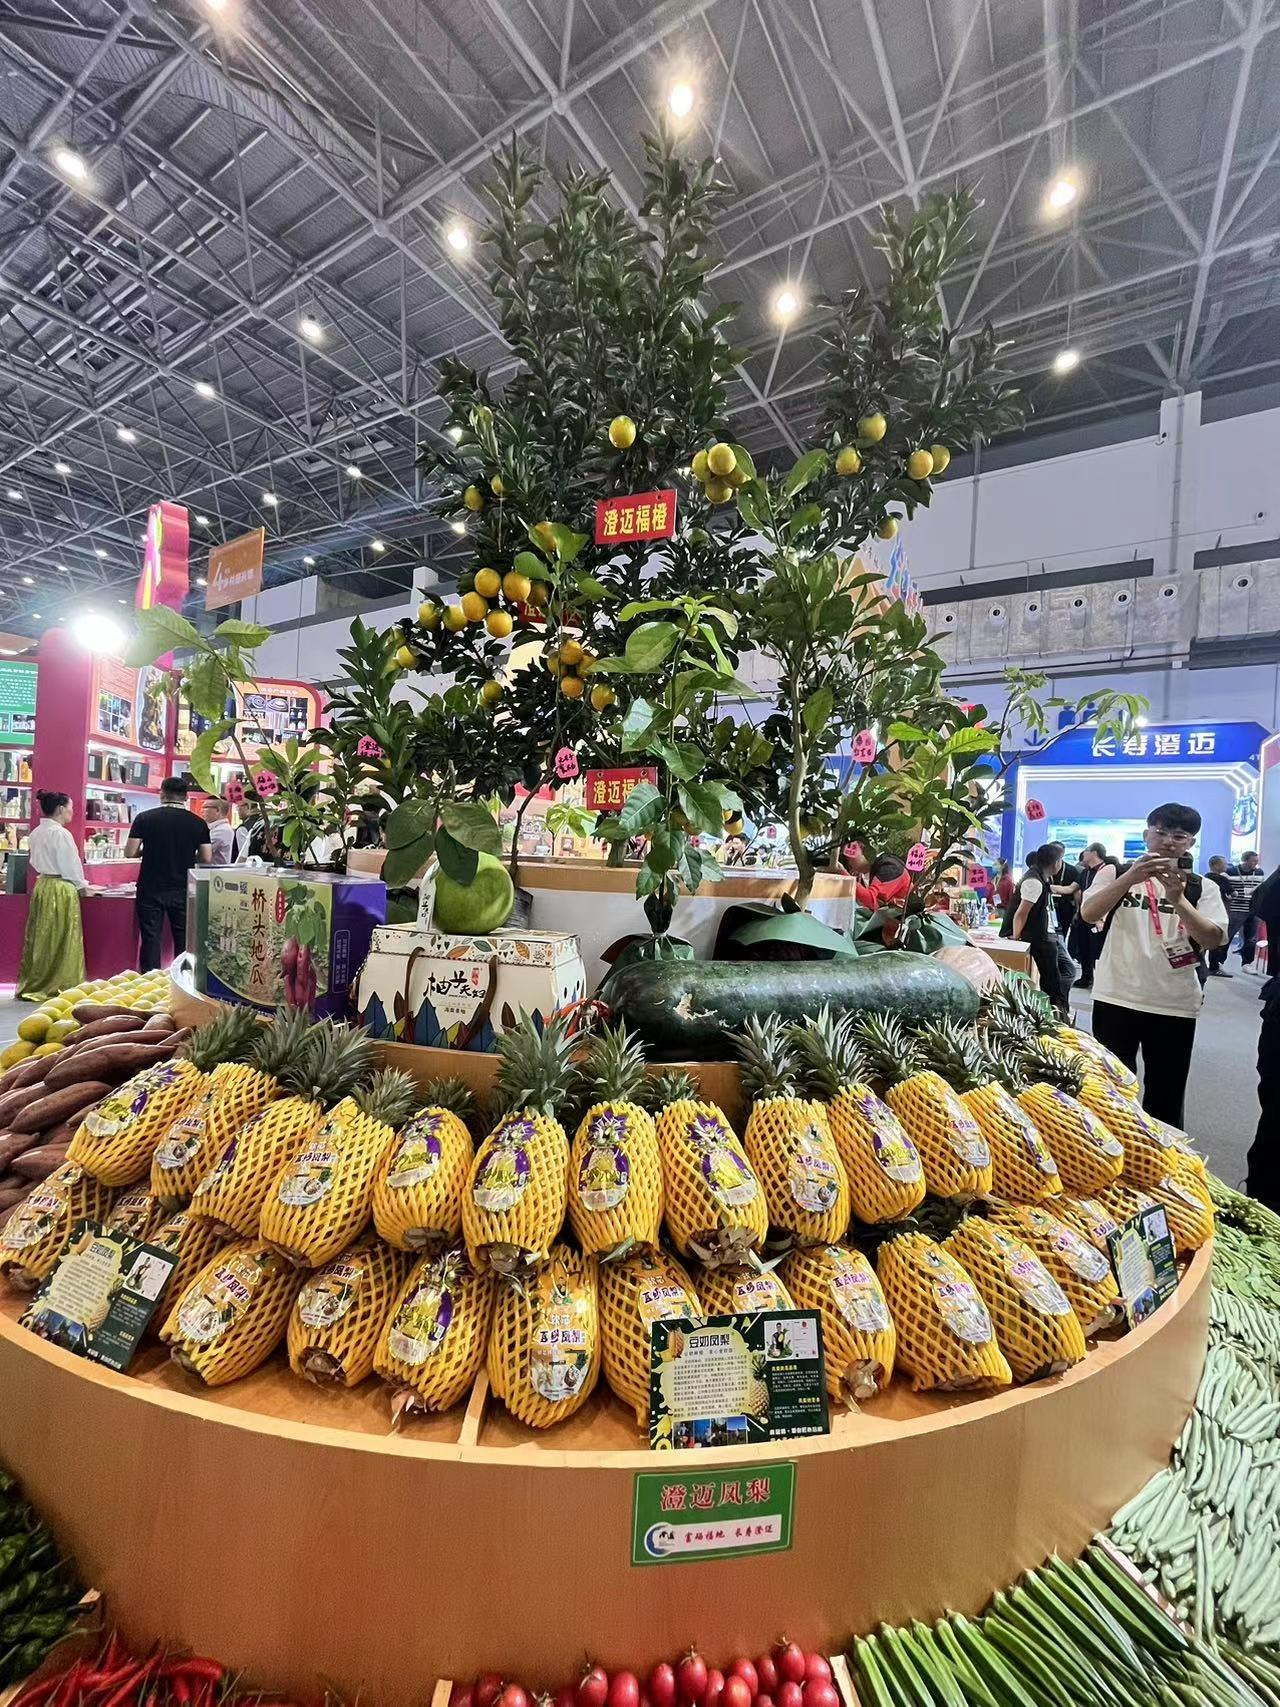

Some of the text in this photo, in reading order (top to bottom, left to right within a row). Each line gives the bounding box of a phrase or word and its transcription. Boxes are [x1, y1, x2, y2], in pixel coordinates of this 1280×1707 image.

[603, 502, 668, 536] 澄迈福橙
[1091, 732, 1216, 757] 长寿澄迈
[593, 778, 652, 804] 澄迈福
[250, 887, 267, 985] 桥头地瓜
[423, 969, 487, 999] 柚子夫妇
[689, 1333, 731, 1349] 豆奶凤梨
[660, 1476, 771, 1511] 澄迈凤梨
